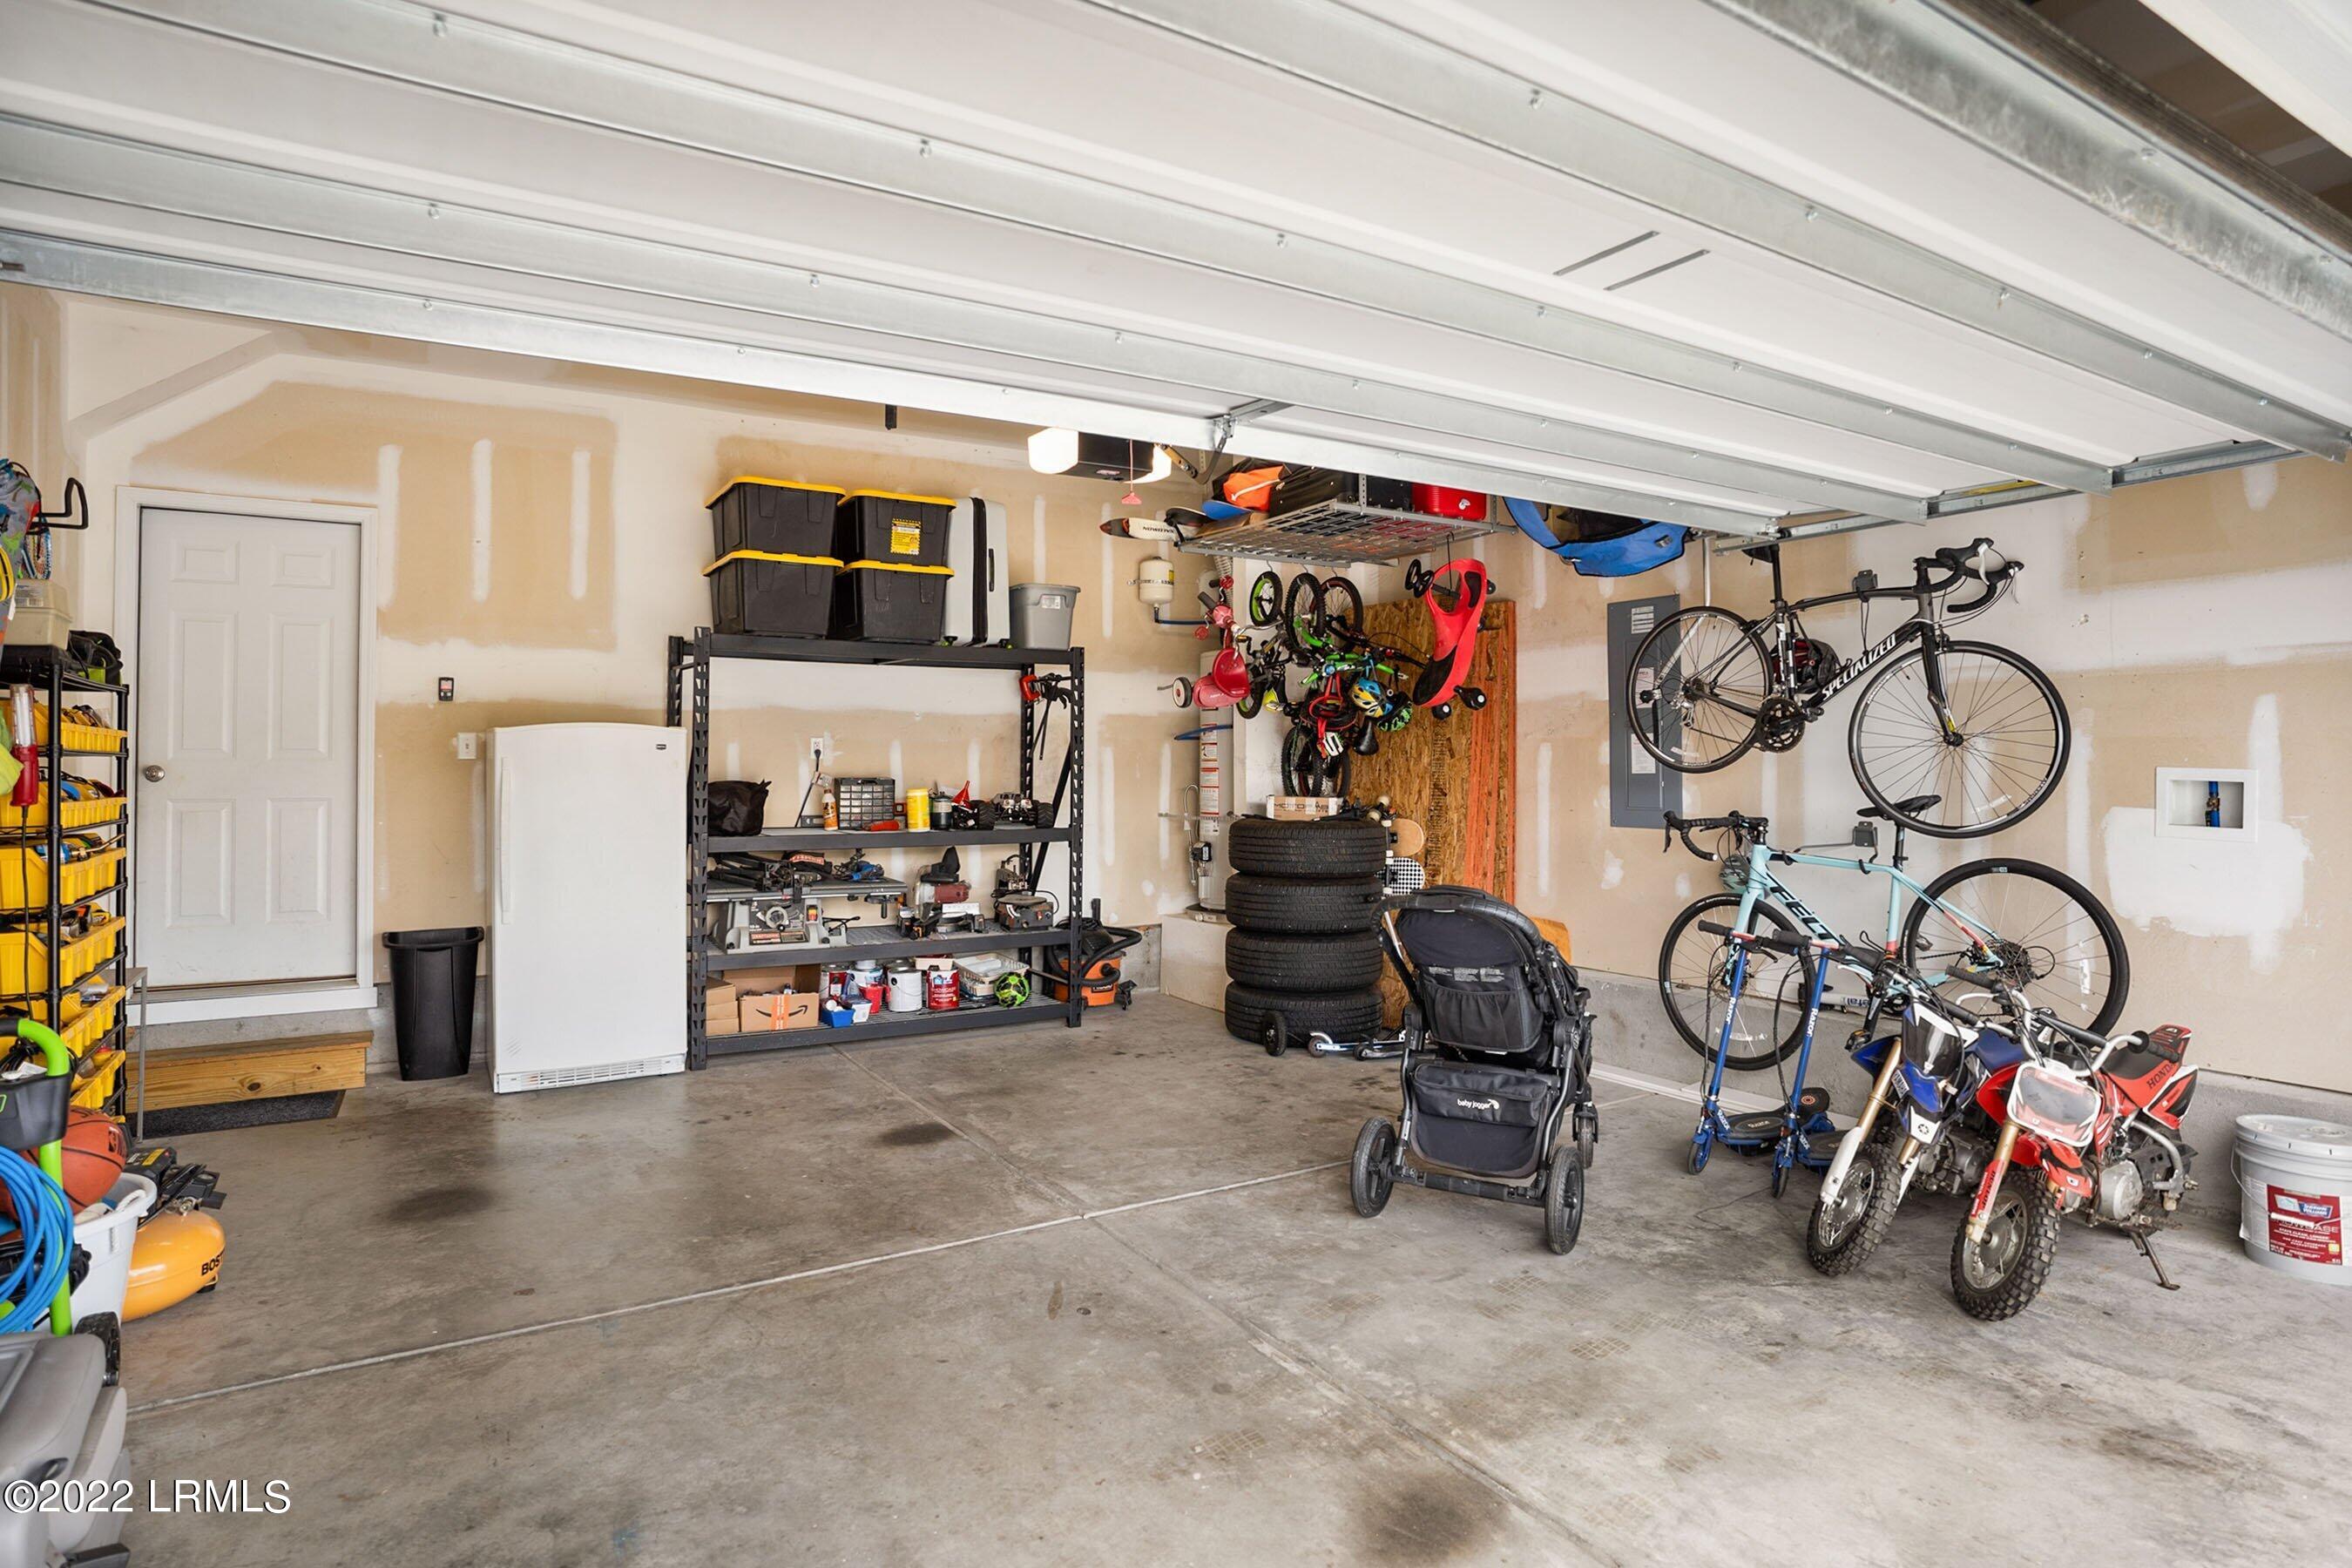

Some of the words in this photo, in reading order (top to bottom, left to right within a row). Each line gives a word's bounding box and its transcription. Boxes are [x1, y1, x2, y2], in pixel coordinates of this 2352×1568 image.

[1821, 633, 1896, 700] SPECIALIZED
[1767, 873, 1846, 946] FELT
[2146, 1063, 2174, 1089] HOND
[1457, 1098, 1472, 1108] baby
